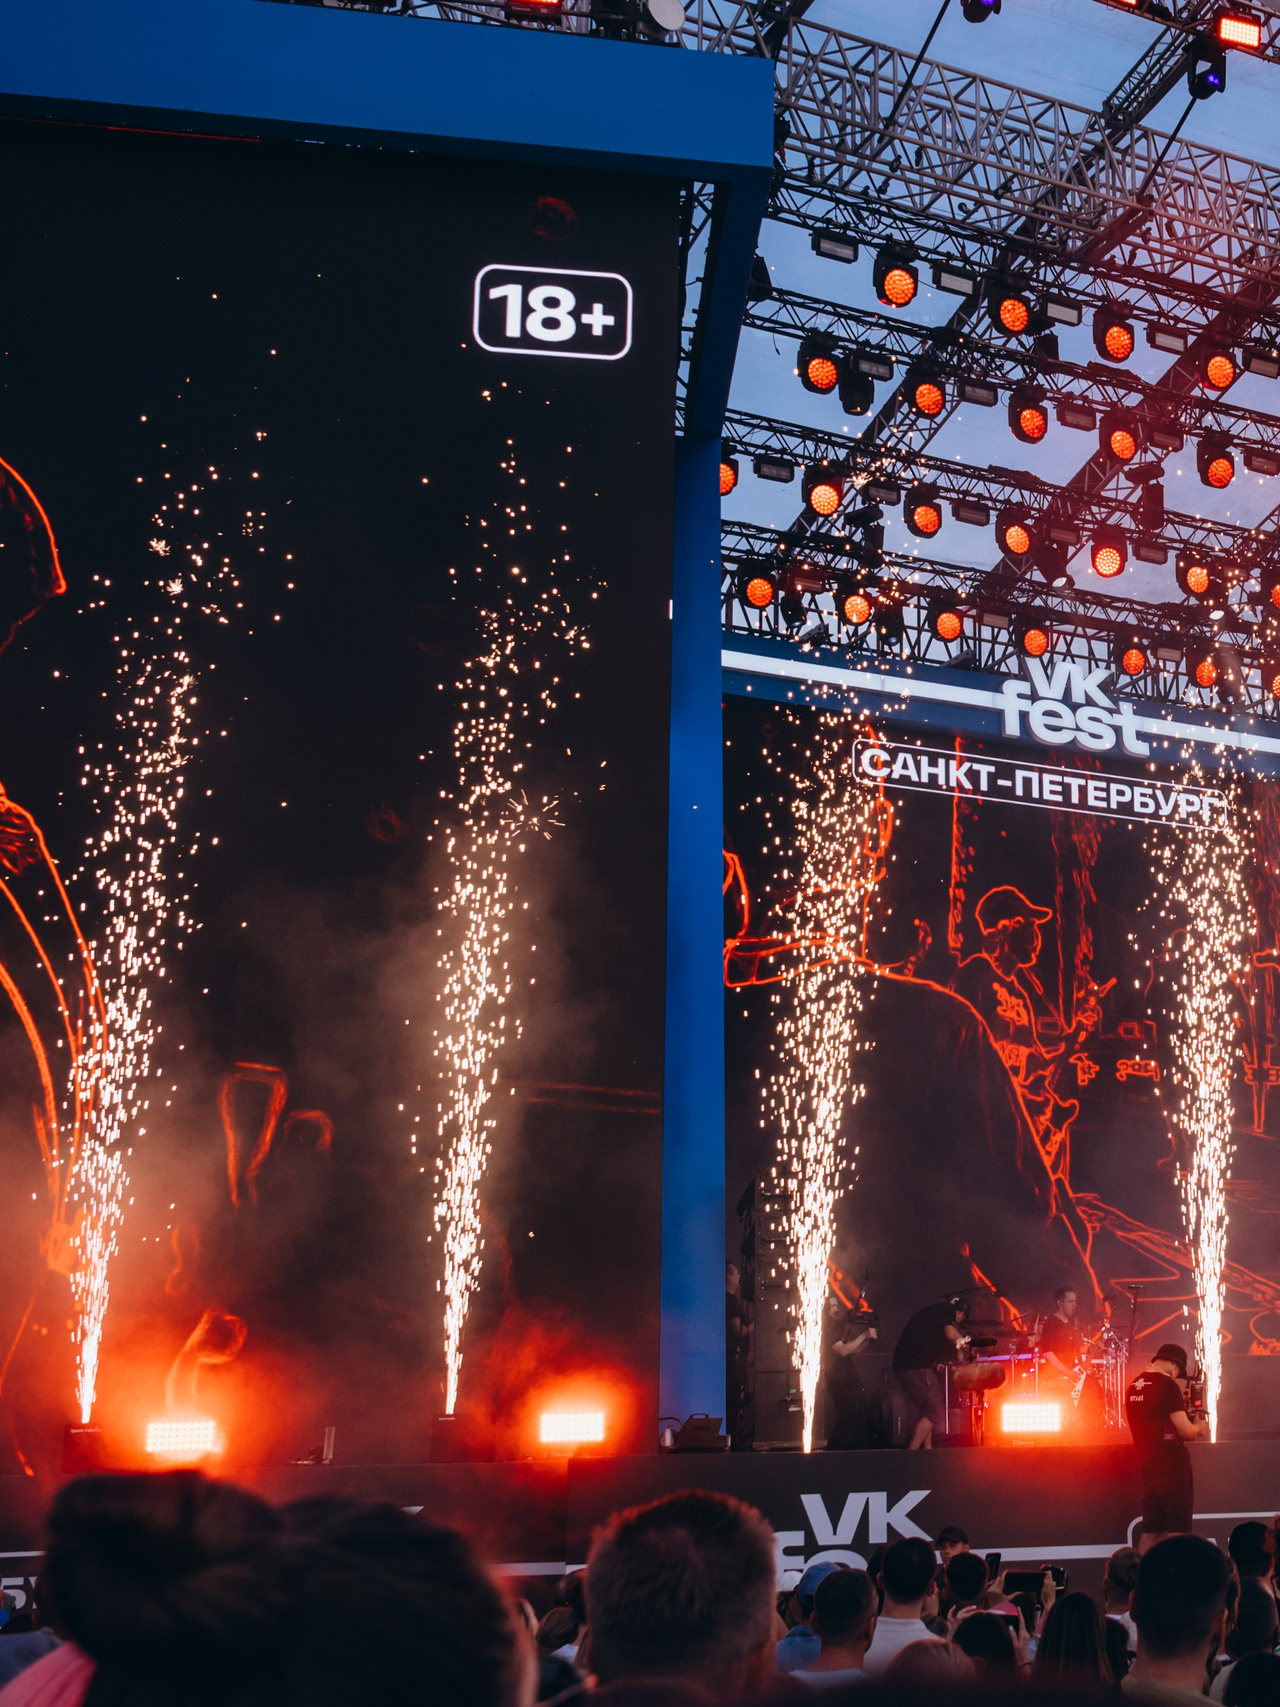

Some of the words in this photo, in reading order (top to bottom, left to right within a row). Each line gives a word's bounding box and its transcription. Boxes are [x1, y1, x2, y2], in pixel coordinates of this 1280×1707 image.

[488, 283, 616, 342] 18+
[1023, 656, 1117, 709] VK
[1001, 679, 1150, 758] fest
[858, 746, 1222, 823] САНКТ-ПЕТЕРБУРГ
[800, 1490, 934, 1546] VK
